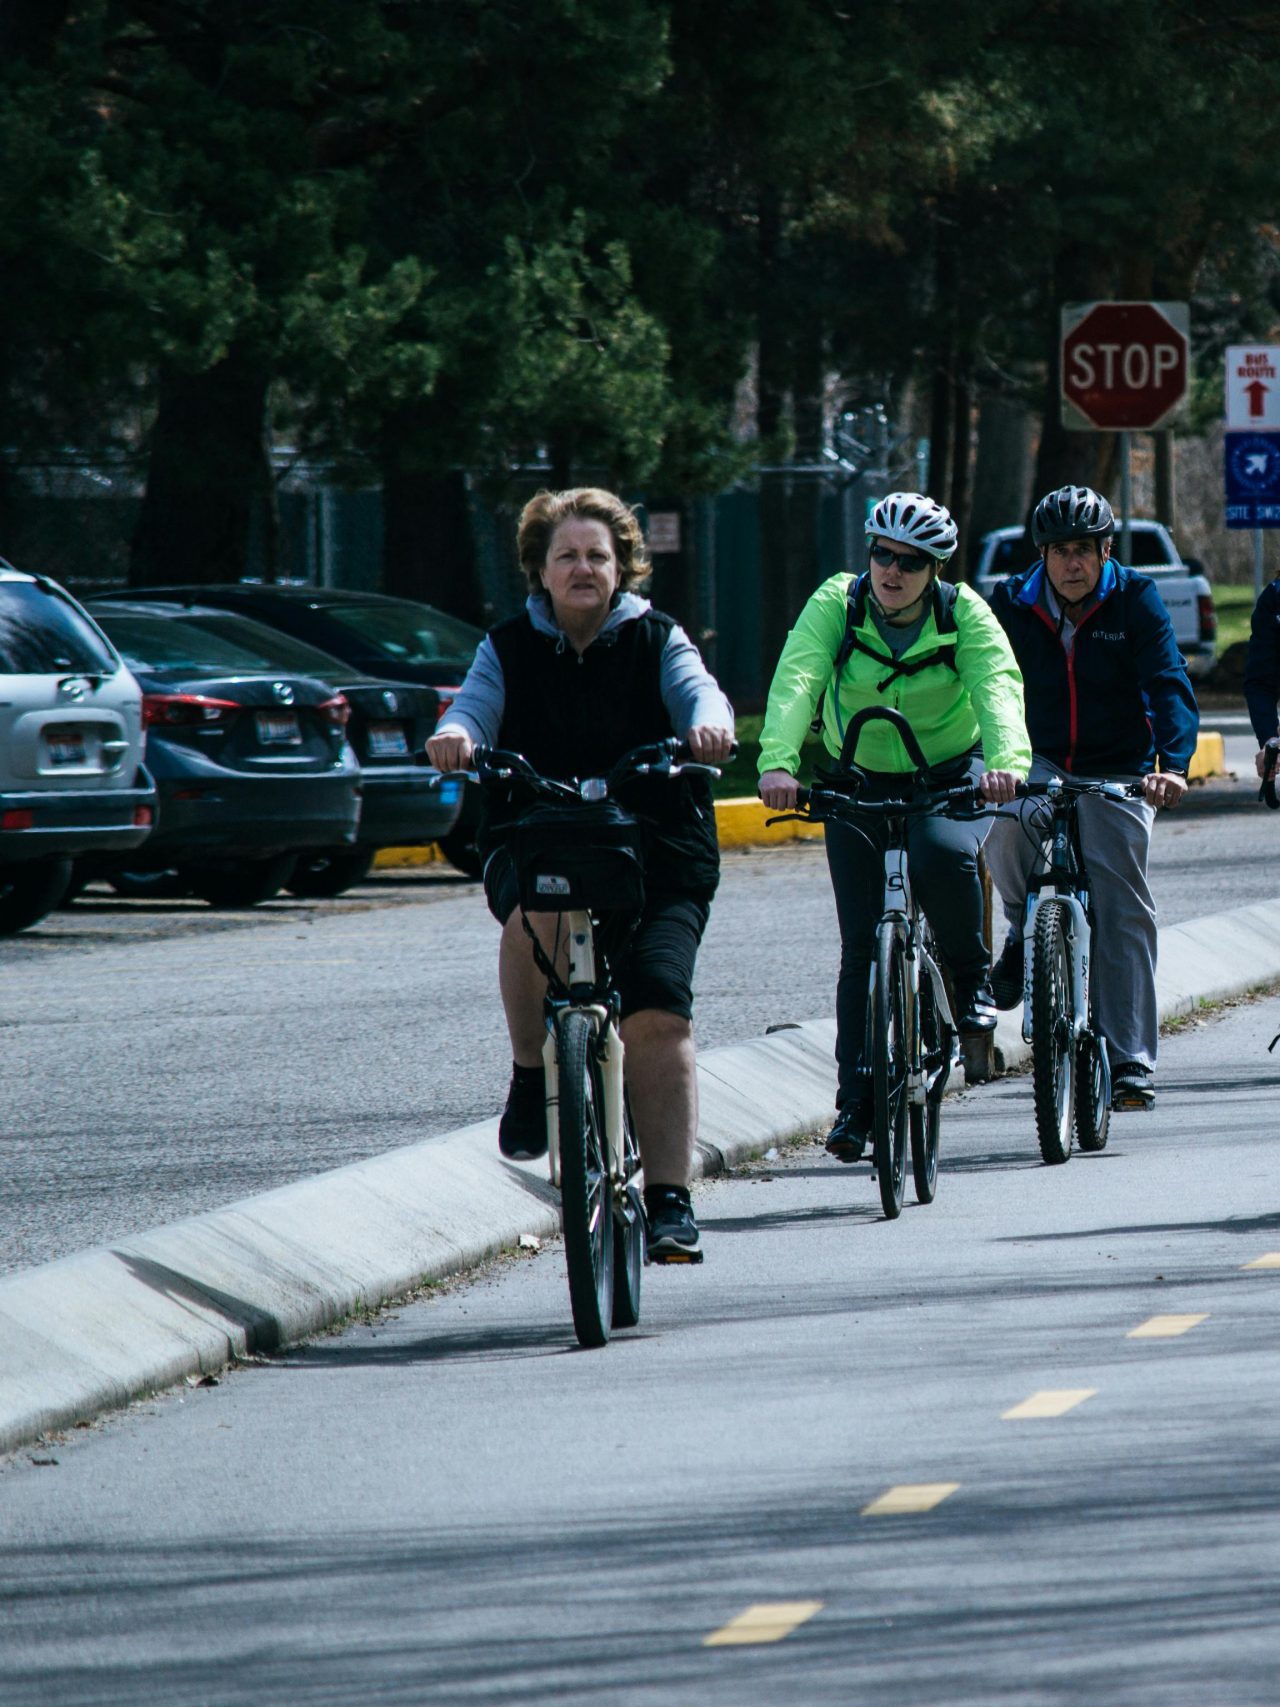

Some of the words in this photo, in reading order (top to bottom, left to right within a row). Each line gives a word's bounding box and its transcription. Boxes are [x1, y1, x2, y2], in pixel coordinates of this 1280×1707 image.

[1244, 353, 1268, 365] BUS
[1070, 343, 1179, 390] STOP
[1237, 366, 1276, 378] ROUTE
